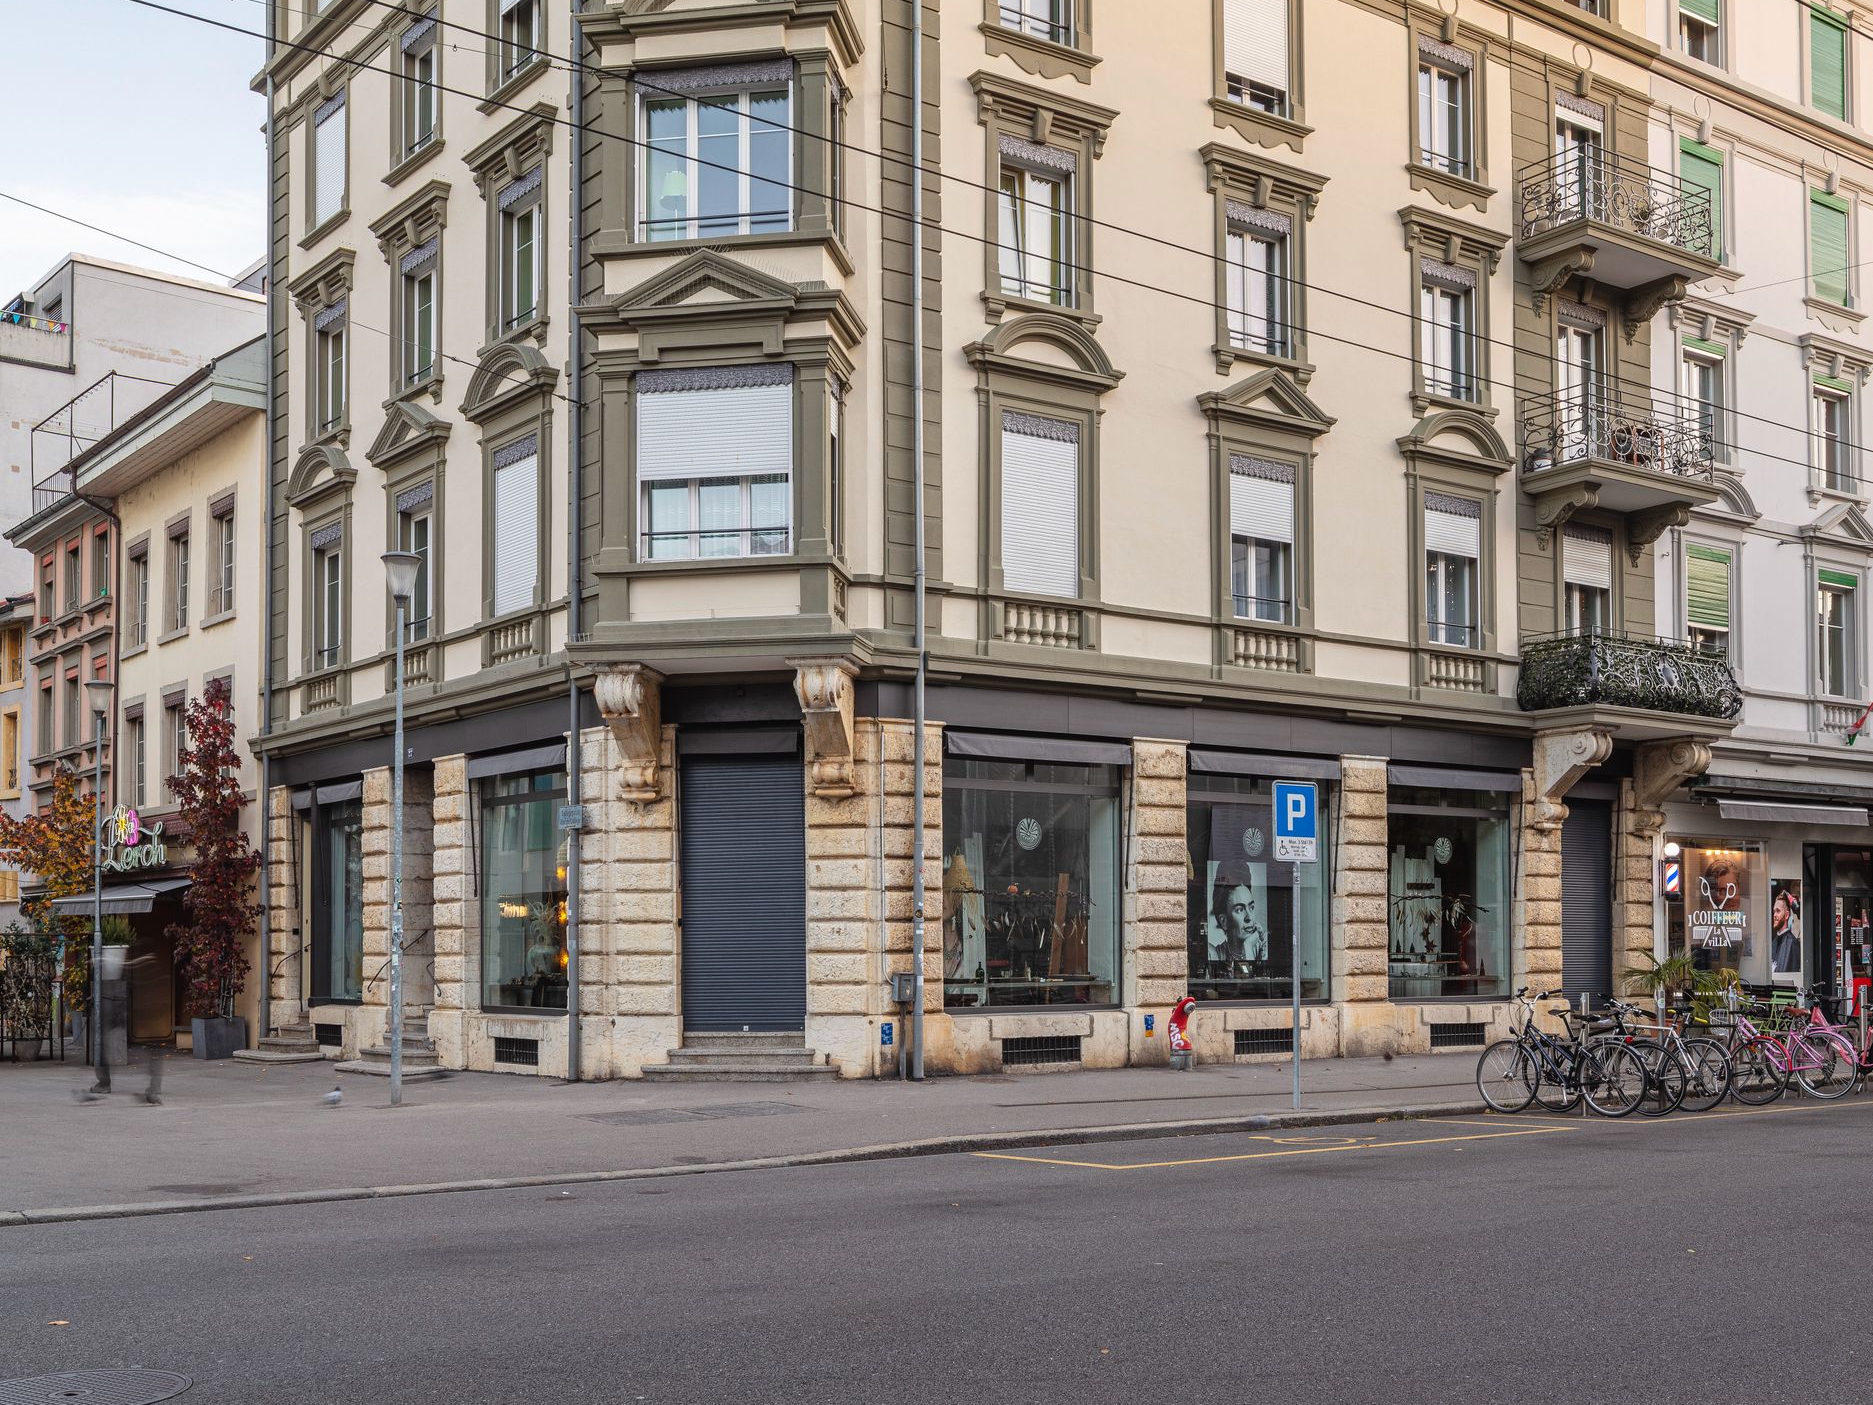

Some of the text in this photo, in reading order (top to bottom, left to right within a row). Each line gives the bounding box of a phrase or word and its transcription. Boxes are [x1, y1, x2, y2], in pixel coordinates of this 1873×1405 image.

[1287, 793, 1306, 831] P
[1692, 910, 1742, 925] COIFFEUR
[1713, 926, 1721, 935] La
